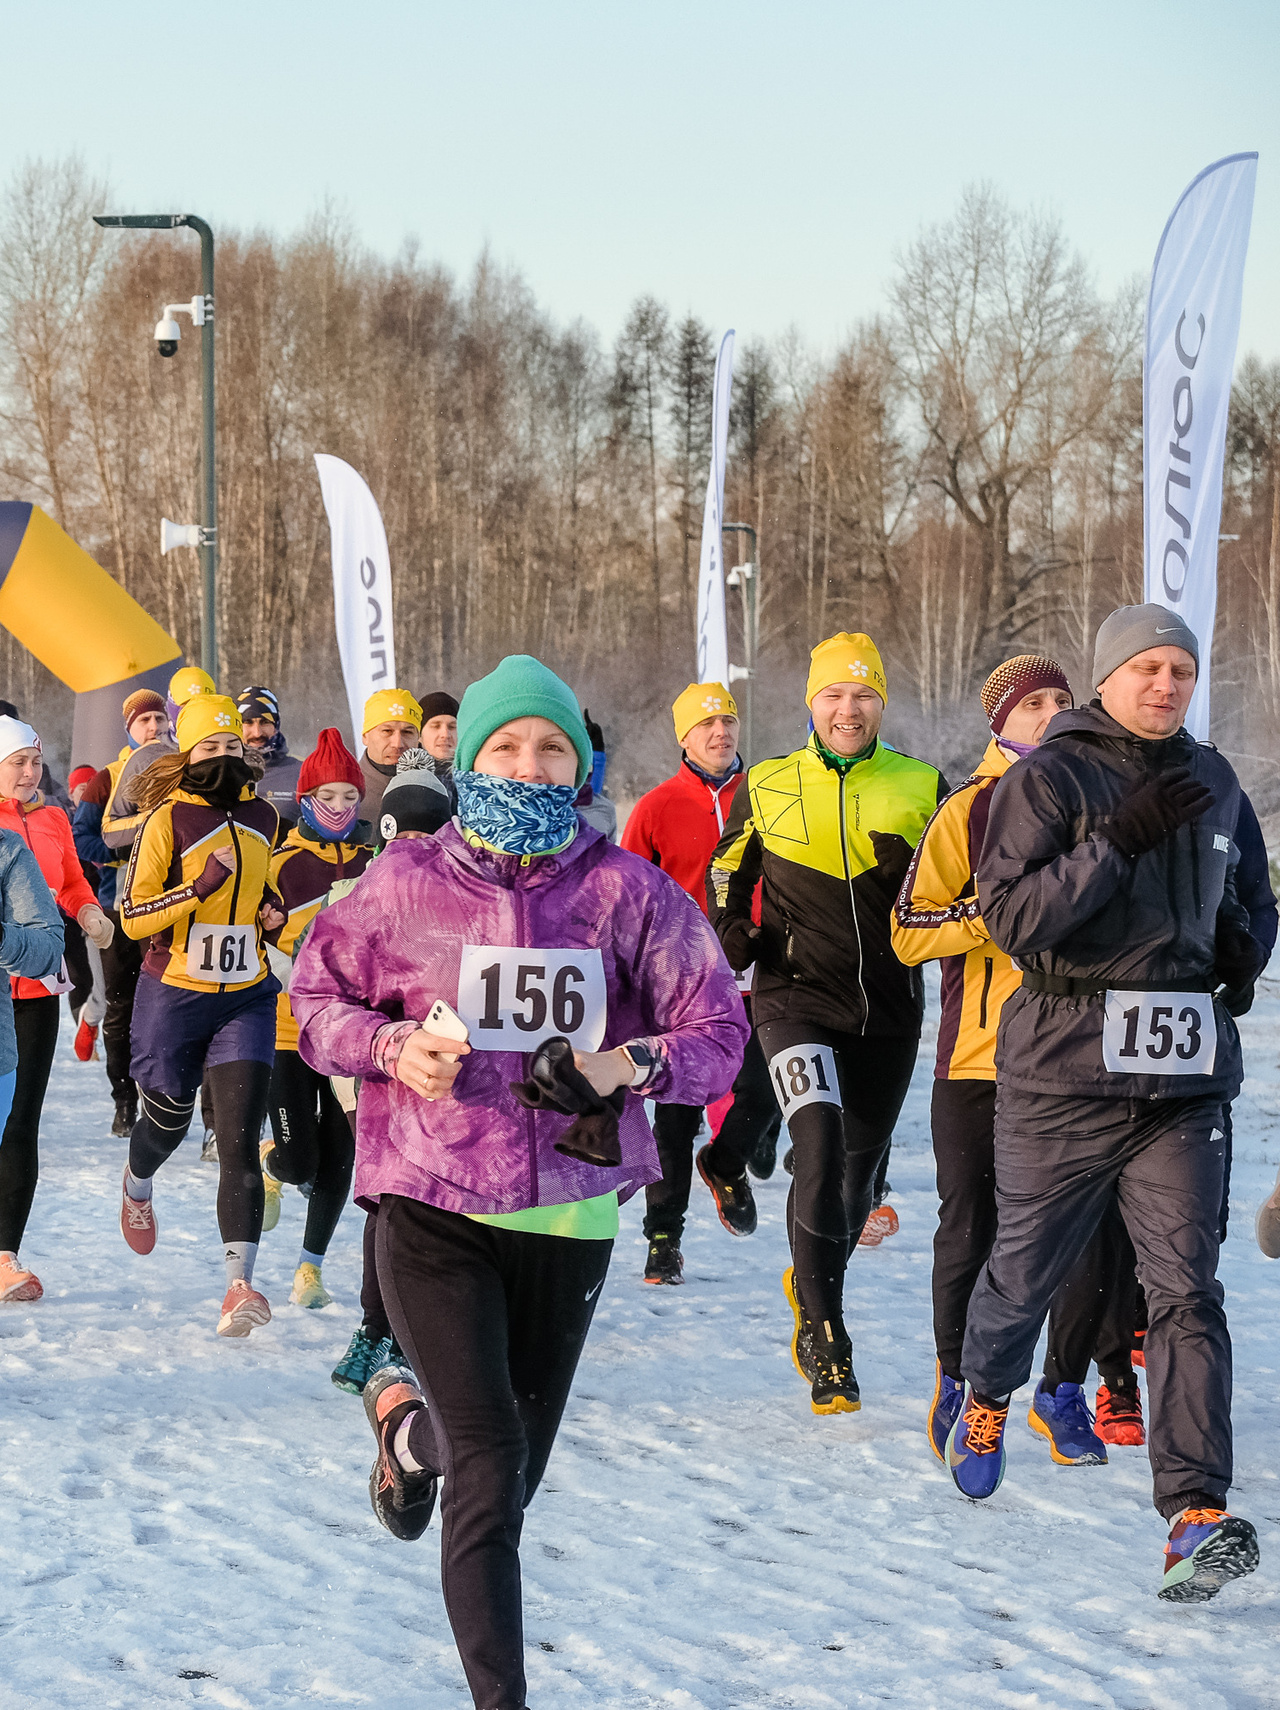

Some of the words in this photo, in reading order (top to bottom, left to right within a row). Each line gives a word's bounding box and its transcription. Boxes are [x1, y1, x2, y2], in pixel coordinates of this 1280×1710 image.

[1162, 308, 1205, 603] ОЛЮС
[200, 934, 249, 973] 161
[479, 963, 586, 1034] 156
[1119, 1006, 1202, 1060] 153
[775, 1053, 831, 1108] 181
[278, 1107, 290, 1136] CRAFT
